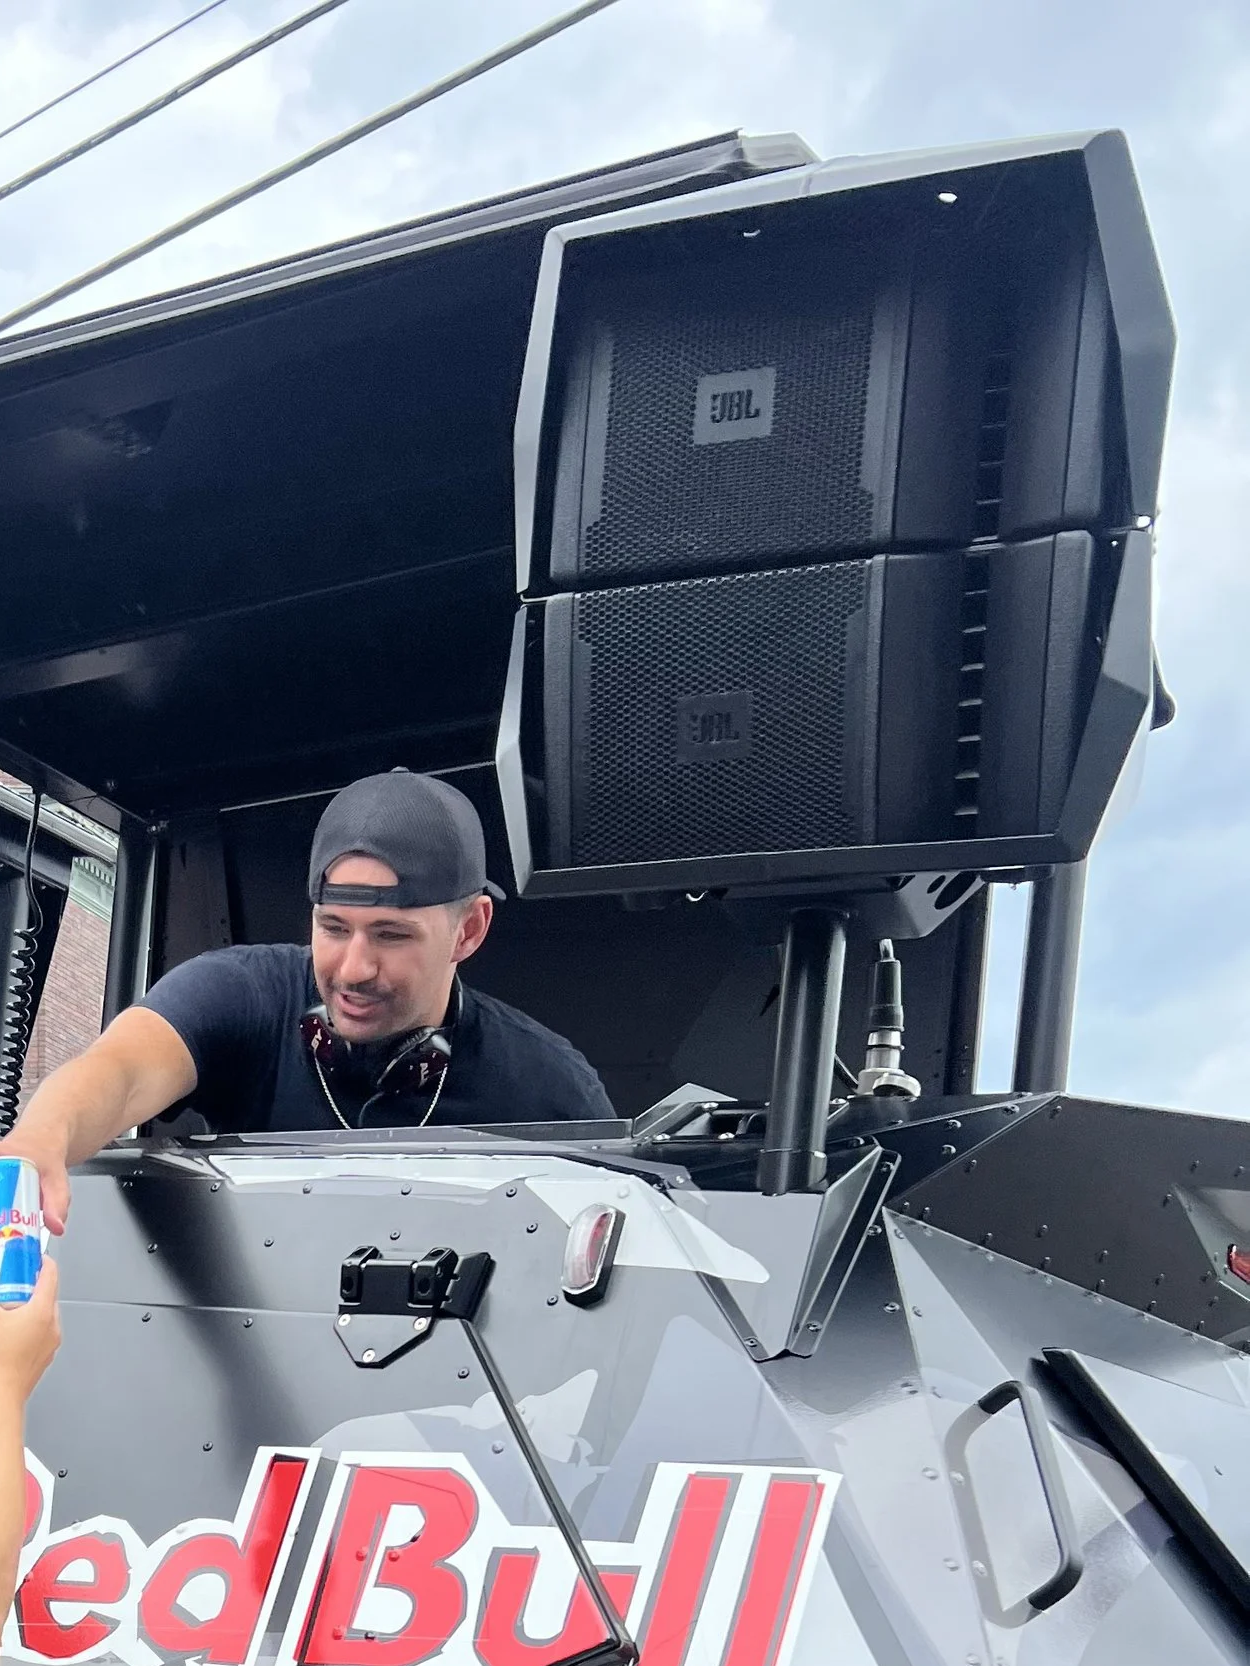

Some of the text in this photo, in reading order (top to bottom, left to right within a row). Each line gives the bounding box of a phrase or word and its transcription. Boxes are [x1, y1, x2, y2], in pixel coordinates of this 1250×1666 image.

[711, 389, 760, 424] JBL
[691, 711, 739, 744] JBL
[10, 1209, 38, 1227] Bull
